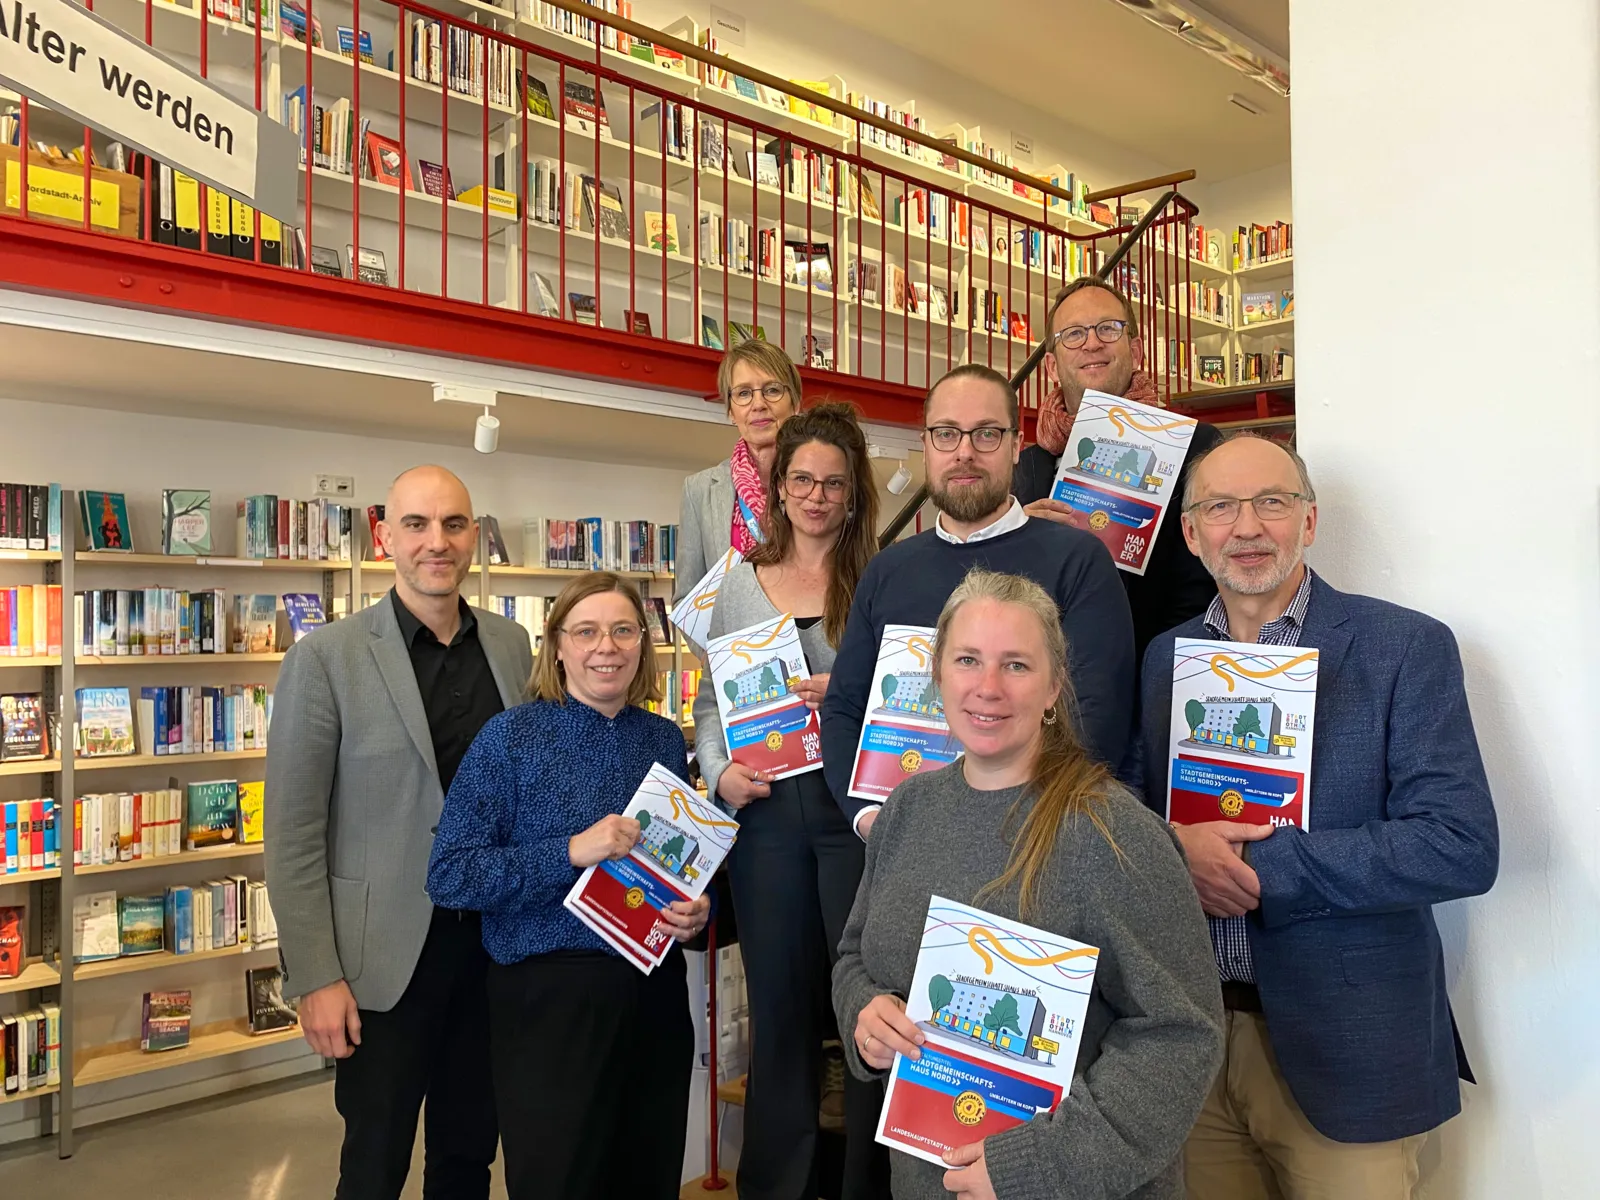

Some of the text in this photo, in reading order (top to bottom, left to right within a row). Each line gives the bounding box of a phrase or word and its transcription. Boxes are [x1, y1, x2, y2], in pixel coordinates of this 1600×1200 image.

[716, 19, 741, 33] Geschichte
[98, 56, 234, 156] werden
[869, 732, 929, 746] STADTGEMEINSCHAFTS-
[1180, 768, 1250, 785] STADTGEMEINSCHAFTS-
[1180, 774, 1196, 783] HAUS
[910, 1064, 930, 1076] HAUS
[955, 1094, 983, 1107] DEMOKRATIE
[958, 1112, 978, 1123] LEBEN
[890, 1125, 944, 1149] LANDESHAUPTSTADT
